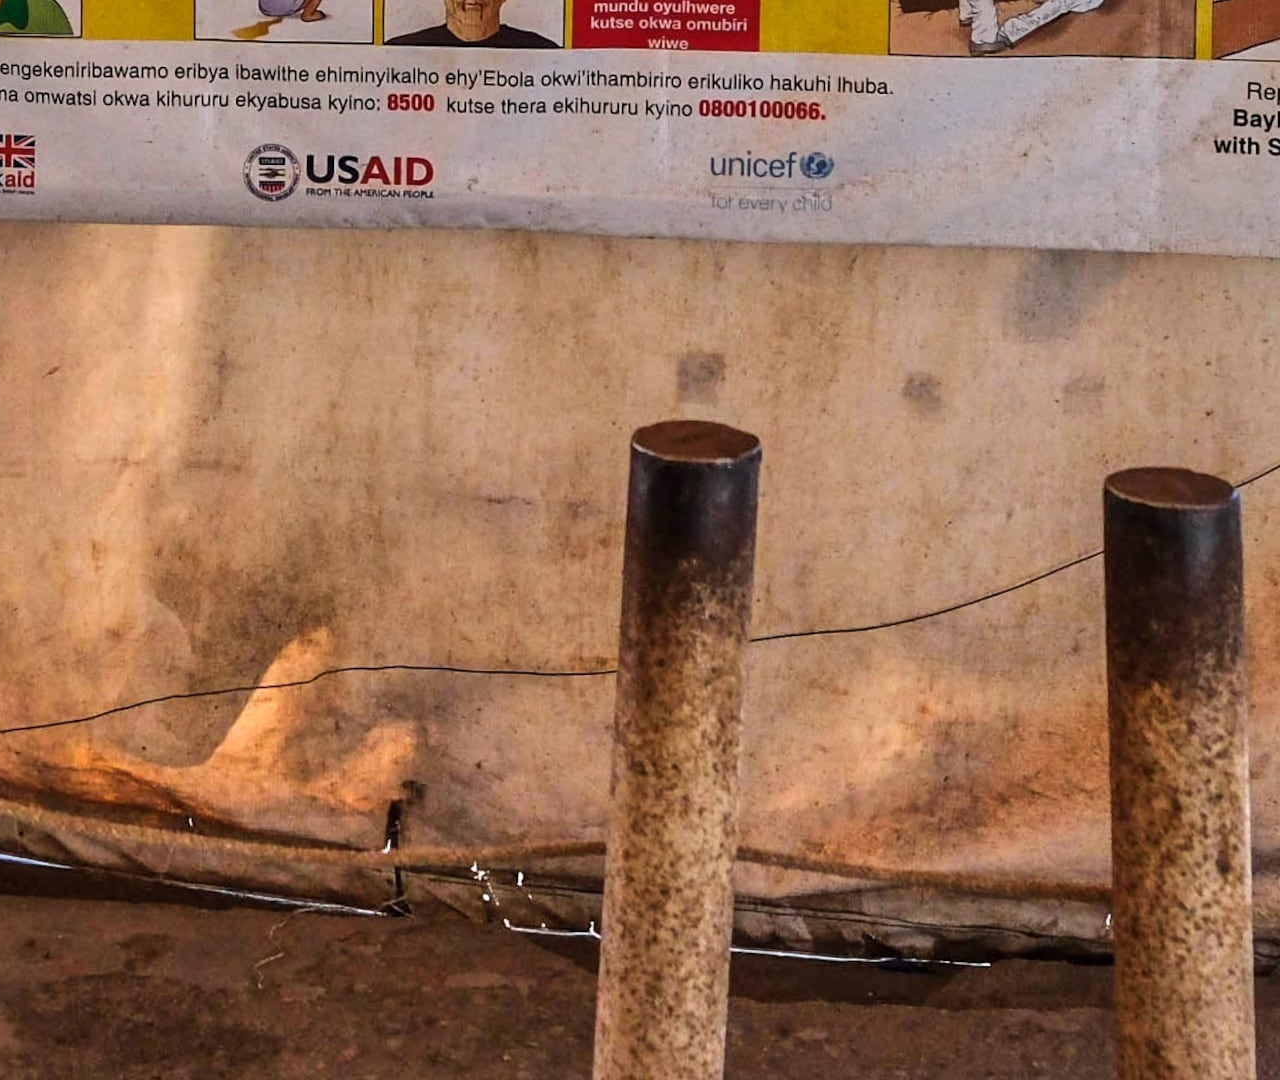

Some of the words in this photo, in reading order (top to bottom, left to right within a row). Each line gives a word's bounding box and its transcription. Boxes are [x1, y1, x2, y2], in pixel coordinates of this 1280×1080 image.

[768, 75, 832, 93] hakuhi
[386, 93, 435, 112] 8500
[445, 94, 496, 113] kutse
[698, 99, 827, 120] 0800100066.
[1214, 136, 1261, 155] with
[305, 155, 434, 186] USAID
[709, 152, 797, 178] unicef
[305, 187, 333, 197] FROM
[334, 188, 352, 197] THE
[353, 189, 399, 198] AMERICAN
[401, 190, 435, 199] PEOPLE
[737, 197, 786, 214] every
[790, 193, 832, 211] child
